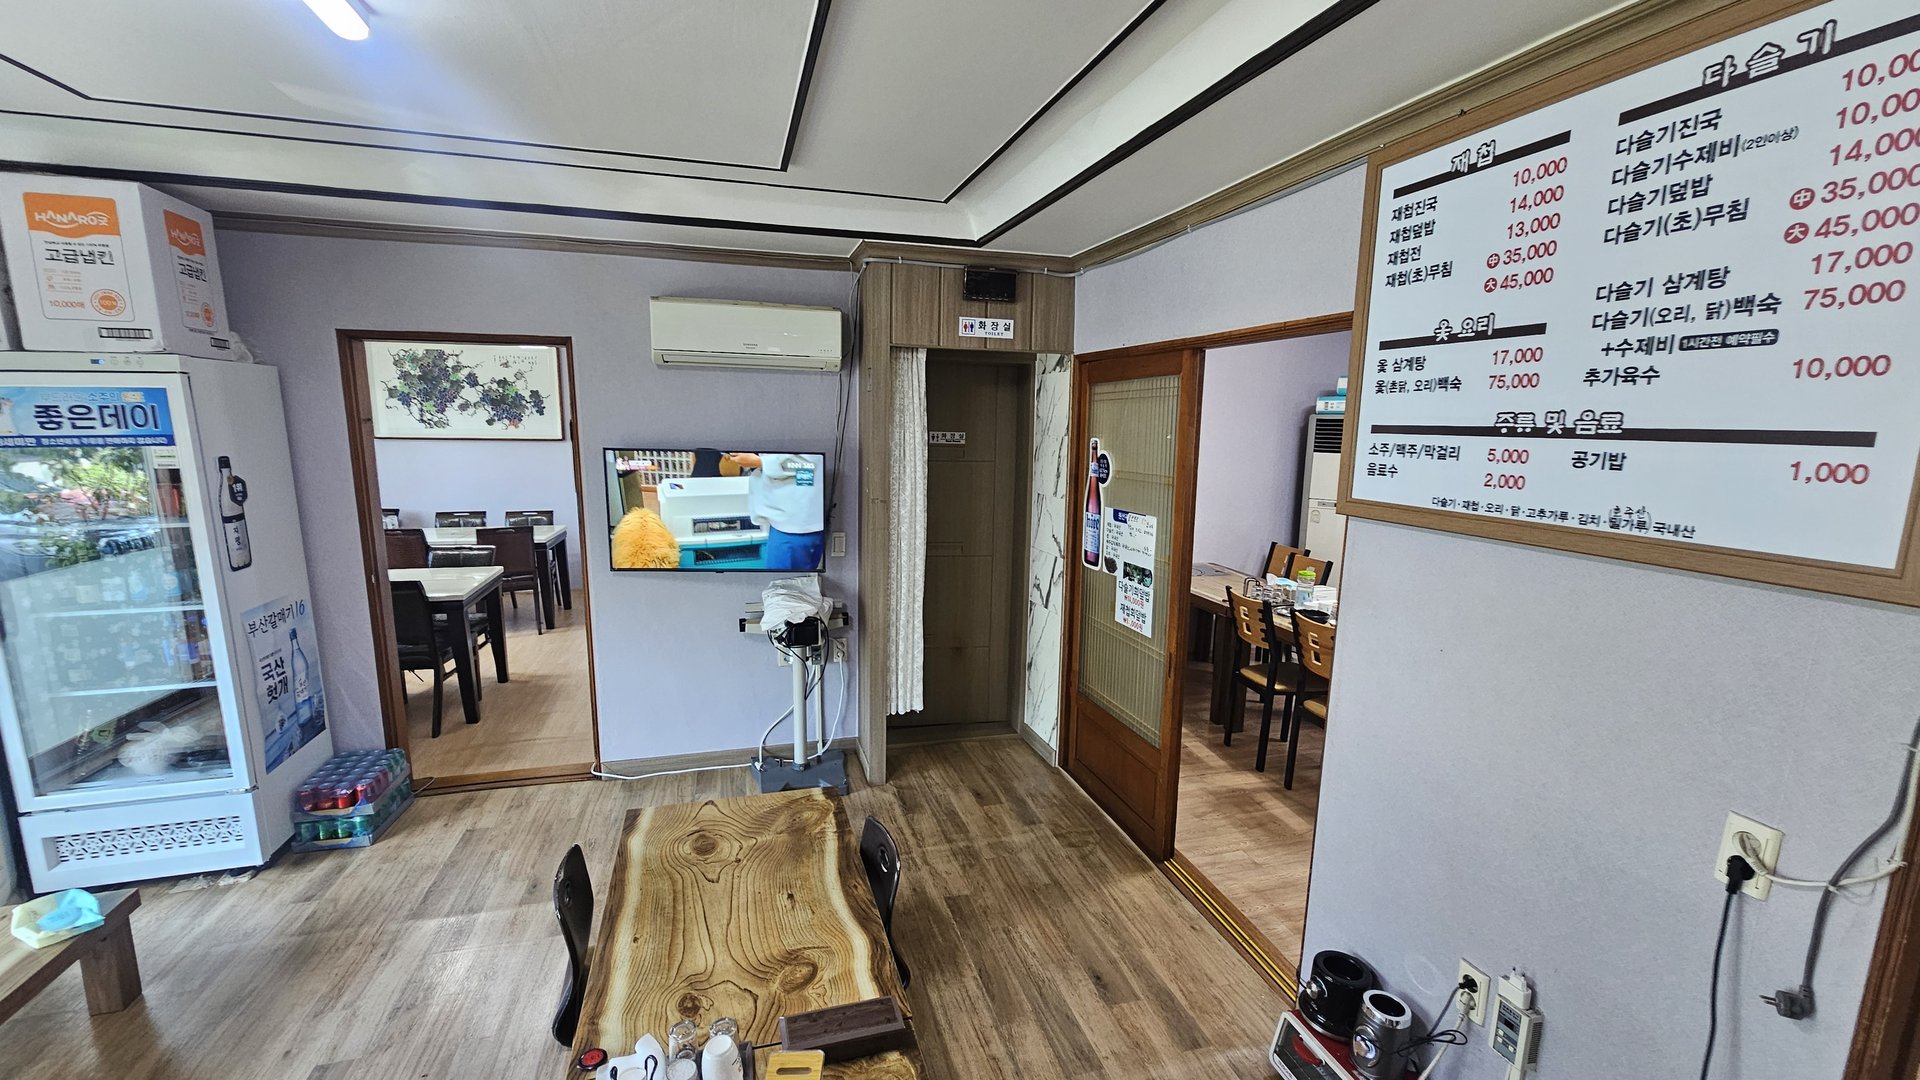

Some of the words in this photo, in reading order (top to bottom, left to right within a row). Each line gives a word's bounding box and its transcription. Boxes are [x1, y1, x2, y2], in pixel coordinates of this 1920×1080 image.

[1701, 19, 1838, 88] 다슬기
[1615, 108, 1723, 156] 다슬기진국
[1450, 140, 1496, 173] 재첩
[1830, 127, 1920, 166] 14,00
[1513, 156, 1568, 187] 10,000
[1509, 185, 1564, 213] 14,000
[1607, 174, 1713, 217] 다슬기덮밥
[1391, 196, 1438, 222] 재첩진국
[1603, 197, 1750, 246] 다슬기(초)무침
[1814, 202, 1920, 239] 45,000
[1389, 219, 1436, 244] 재첩덮밥
[1506, 212, 1561, 240] 13,000
[44, 248, 115, 265] 고급냅킨
[1387, 245, 1422, 266] 재첩전
[1503, 240, 1558, 265] 35,000
[1811, 241, 1914, 275] 17,000
[1385, 261, 1453, 288] 재첩(초)무침
[1500, 267, 1554, 290] 45,000
[1595, 277, 1654, 303] 다슬기
[1662, 266, 1731, 295] 삼계탕
[1804, 280, 1906, 310] 75,000
[1433, 318, 1453, 342] 옻
[1457, 312, 1496, 338] 요리
[1725, 331, 1775, 346] 예약필수
[1391, 355, 1427, 373] 삼계탕
[1492, 346, 1543, 366] 17,000
[1792, 354, 1892, 380] 10,000
[1489, 372, 1540, 391] 75,000
[1583, 365, 1660, 387] 추가육수
[33, 404, 160, 431] 좋은데이
[1494, 411, 1537, 434] 주류
[1545, 409, 1567, 435] 및
[1573, 409, 1625, 435] 음료
[1487, 448, 1530, 465] 5,000
[1571, 450, 1627, 471] 공기밥
[1366, 462, 1399, 478] 음료수
[1484, 473, 1526, 490] 2,000
[1790, 461, 1870, 485] 1,000
[261, 656, 286, 681] 국산
[266, 675, 289, 704] 헛개
